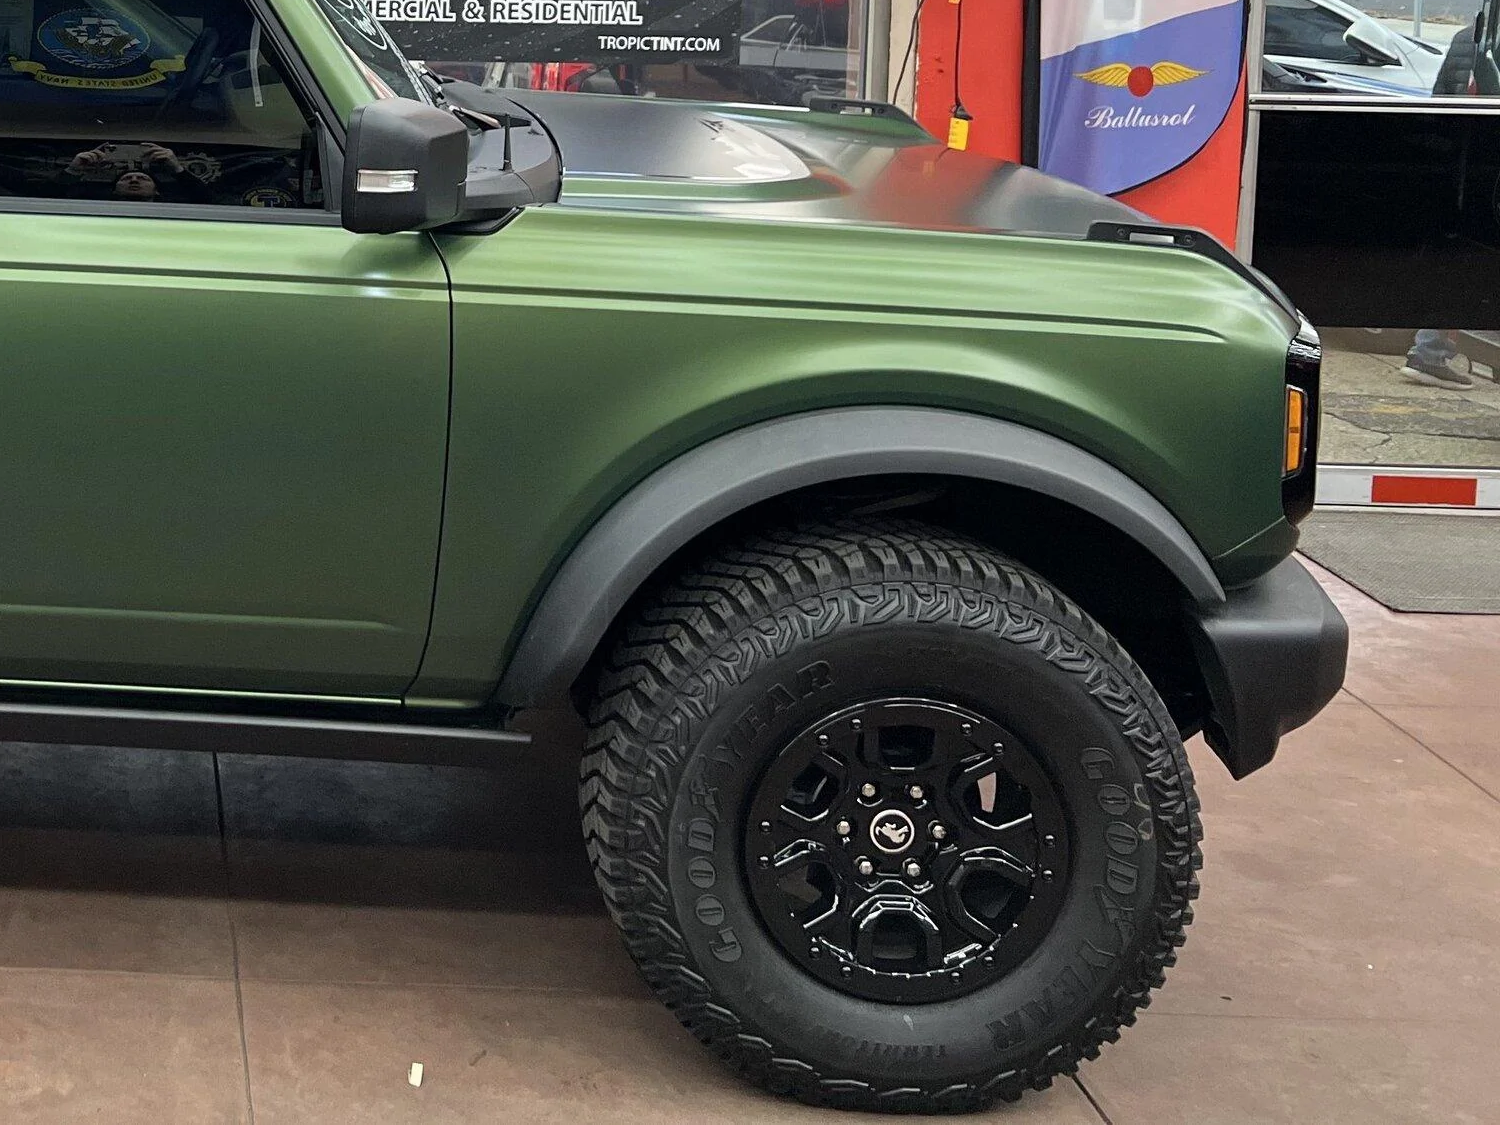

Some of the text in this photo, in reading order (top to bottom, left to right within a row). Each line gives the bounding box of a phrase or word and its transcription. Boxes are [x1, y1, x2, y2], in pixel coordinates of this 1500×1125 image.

[597, 35, 720, 52] TROPICTINT.COM
[687, 660, 836, 963] GOODYEAR
[988, 747, 1140, 1051] GOODYEAR
